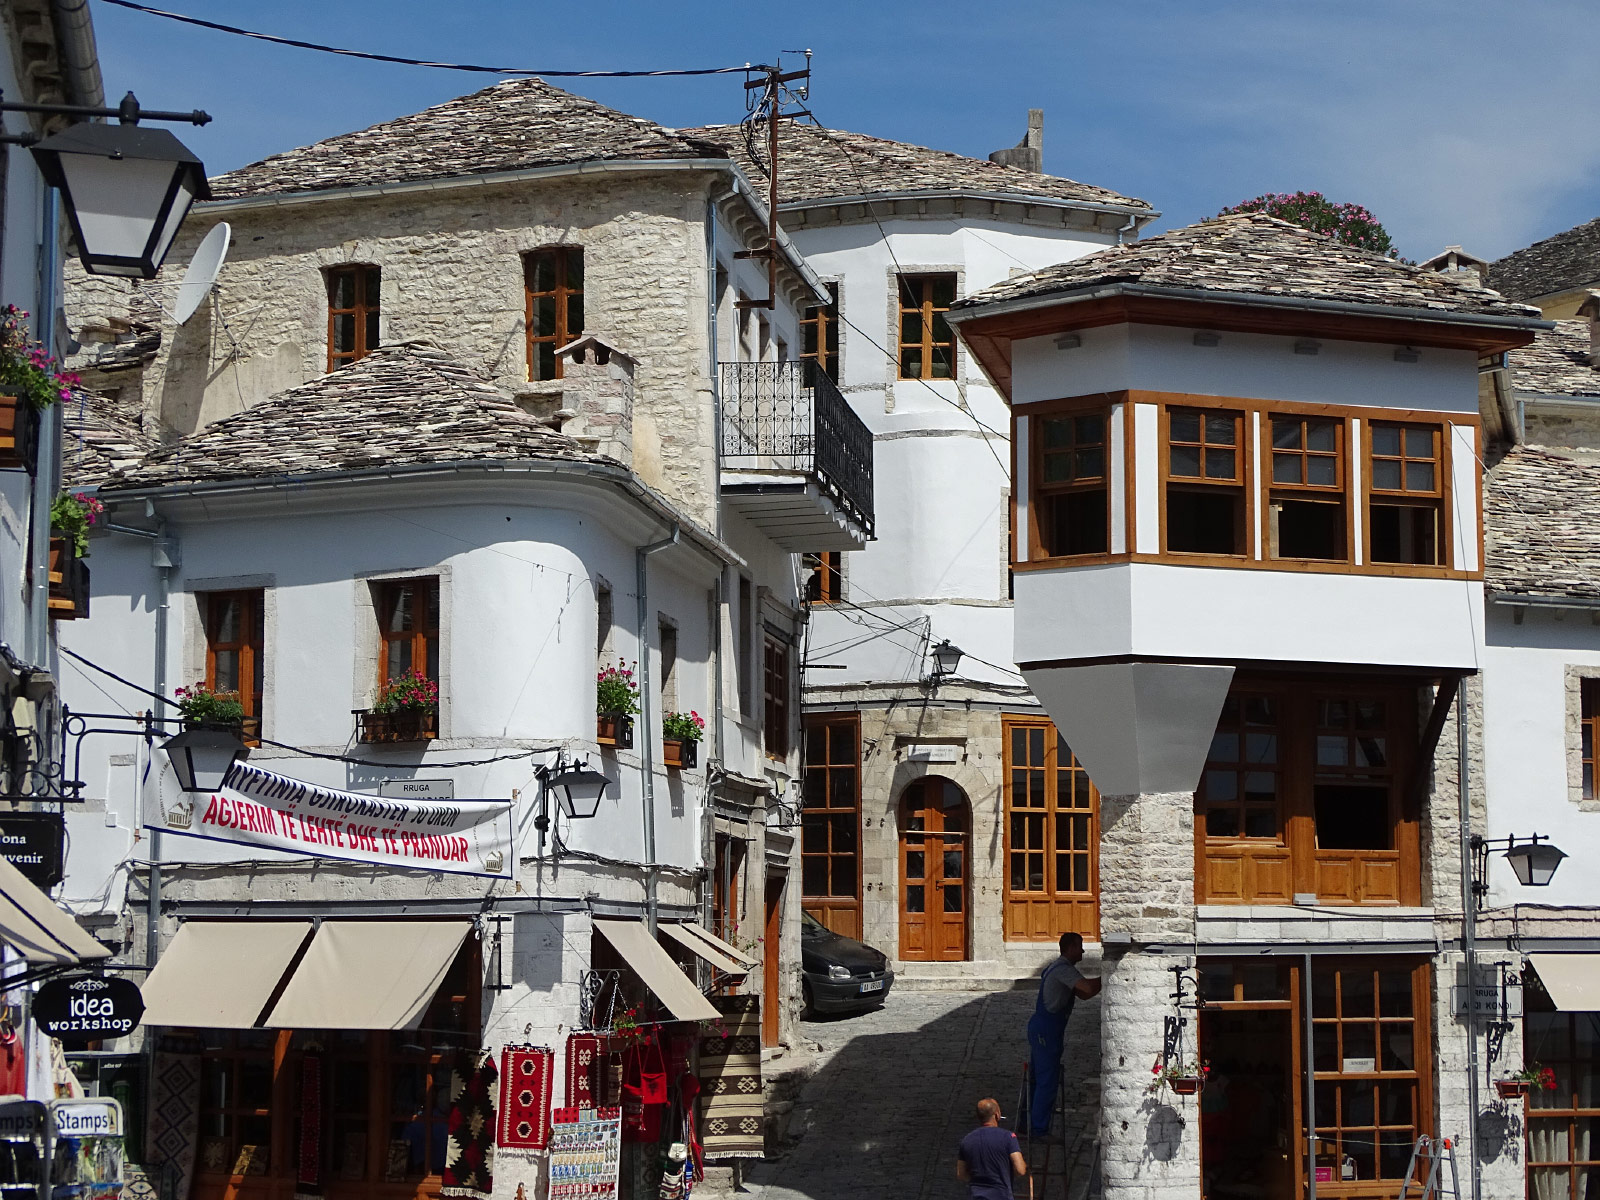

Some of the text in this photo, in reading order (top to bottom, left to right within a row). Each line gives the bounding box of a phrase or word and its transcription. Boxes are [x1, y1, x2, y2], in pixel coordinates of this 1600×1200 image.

[403, 784, 430, 792] RRUGA
[411, 805, 429, 824] JU
[427, 806, 461, 827] URON
[202, 795, 278, 836] AGJERIM
[278, 804, 297, 840] TË
[300, 813, 344, 848] LEHTË
[346, 823, 379, 853] DHE
[381, 823, 399, 855] TË
[401, 830, 469, 863] PRANUAR
[70, 993, 114, 1017] idea
[48, 1017, 132, 1032] workshop
[57, 1109, 108, 1132] Stamps
